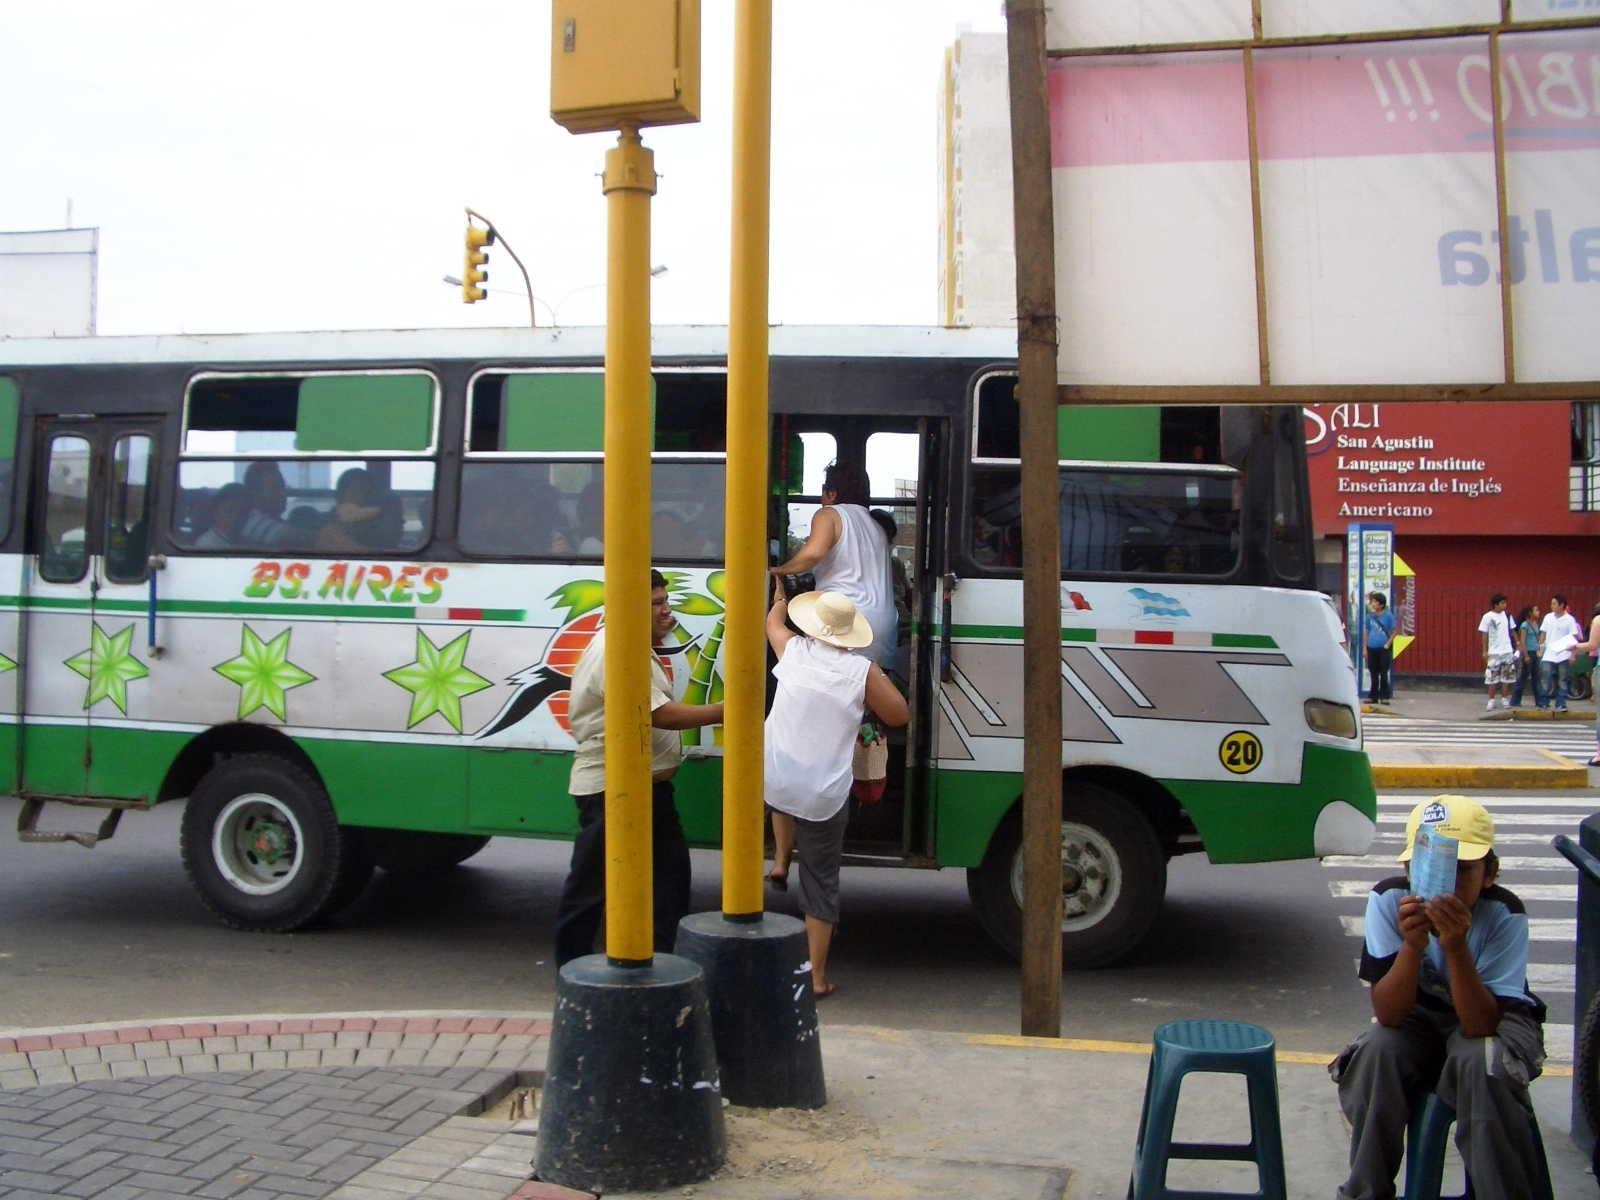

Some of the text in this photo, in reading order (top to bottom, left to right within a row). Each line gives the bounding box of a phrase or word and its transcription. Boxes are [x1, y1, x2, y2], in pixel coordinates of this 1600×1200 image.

[1337, 434, 1368, 448] San
[1337, 456, 1486, 473] Language Institute
[1338, 477, 1502, 497] Enseñanza de Inglés
[1339, 502, 1433, 517] Americano
[243, 560, 449, 603] BS. AIRES
[1226, 740, 1257, 765] 20
